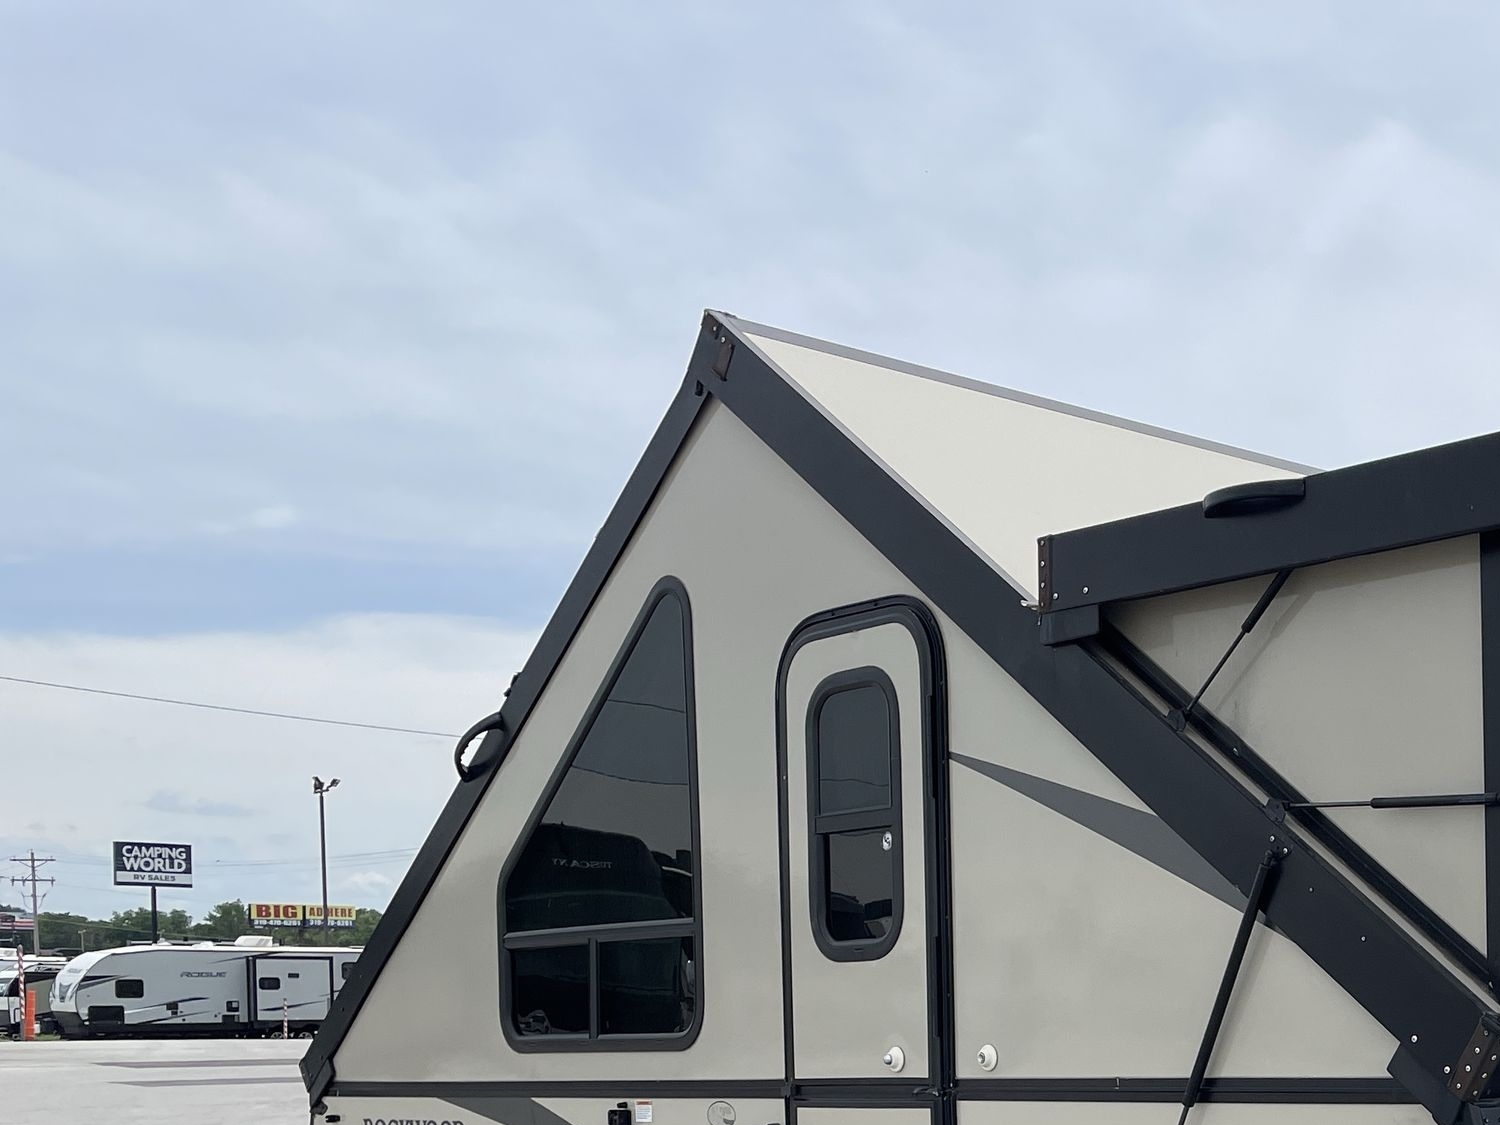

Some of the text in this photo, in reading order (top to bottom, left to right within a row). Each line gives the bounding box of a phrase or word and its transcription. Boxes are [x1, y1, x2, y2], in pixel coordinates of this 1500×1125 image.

[122, 845, 186, 860] CAMPING
[122, 857, 187, 872] WORLD
[256, 904, 298, 918] BIG
[309, 907, 323, 917] AD
